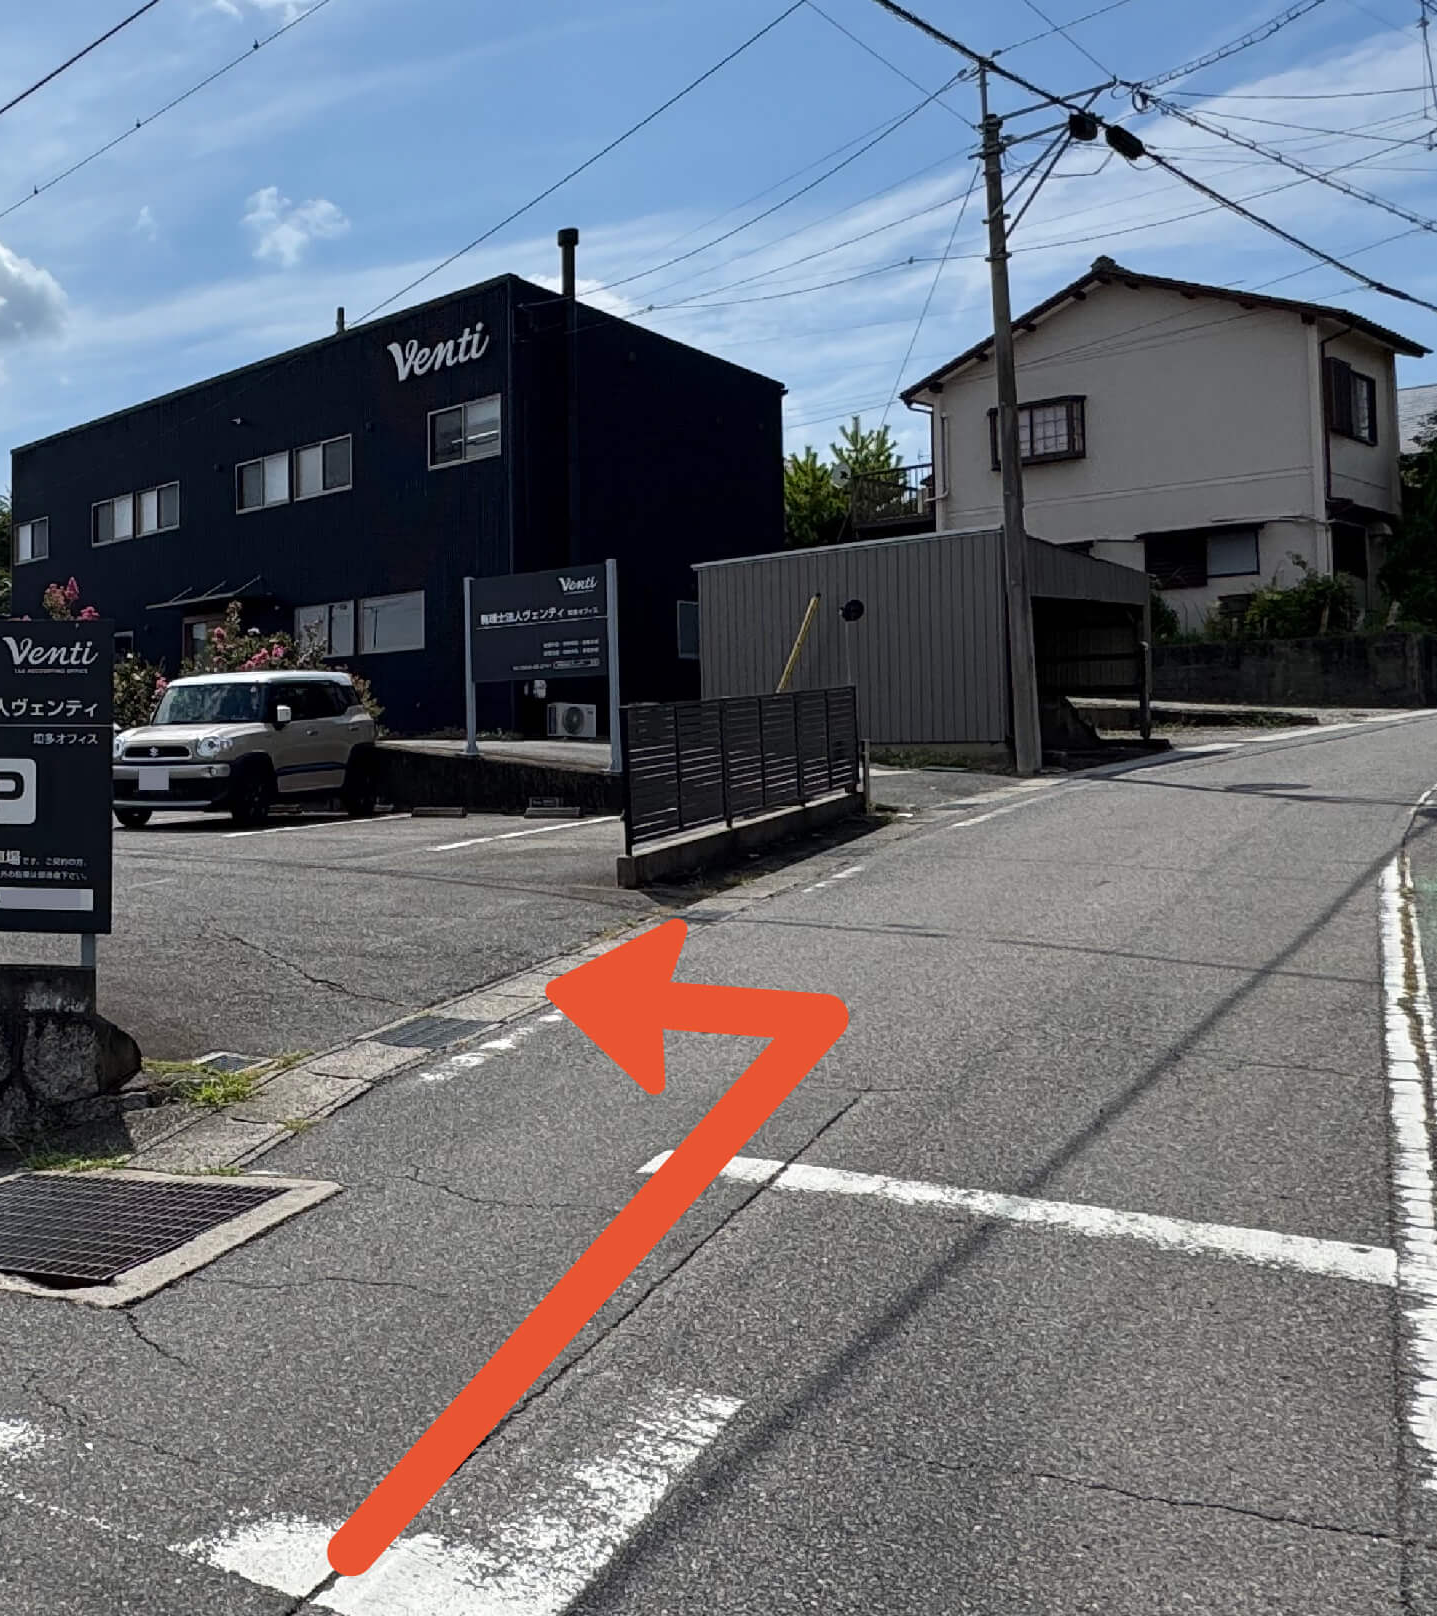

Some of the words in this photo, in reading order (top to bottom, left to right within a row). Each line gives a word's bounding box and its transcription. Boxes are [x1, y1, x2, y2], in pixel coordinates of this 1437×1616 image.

[386, 321, 490, 382] Venti
[557, 576, 598, 592] Venti
[2, 636, 99, 665] Venti
